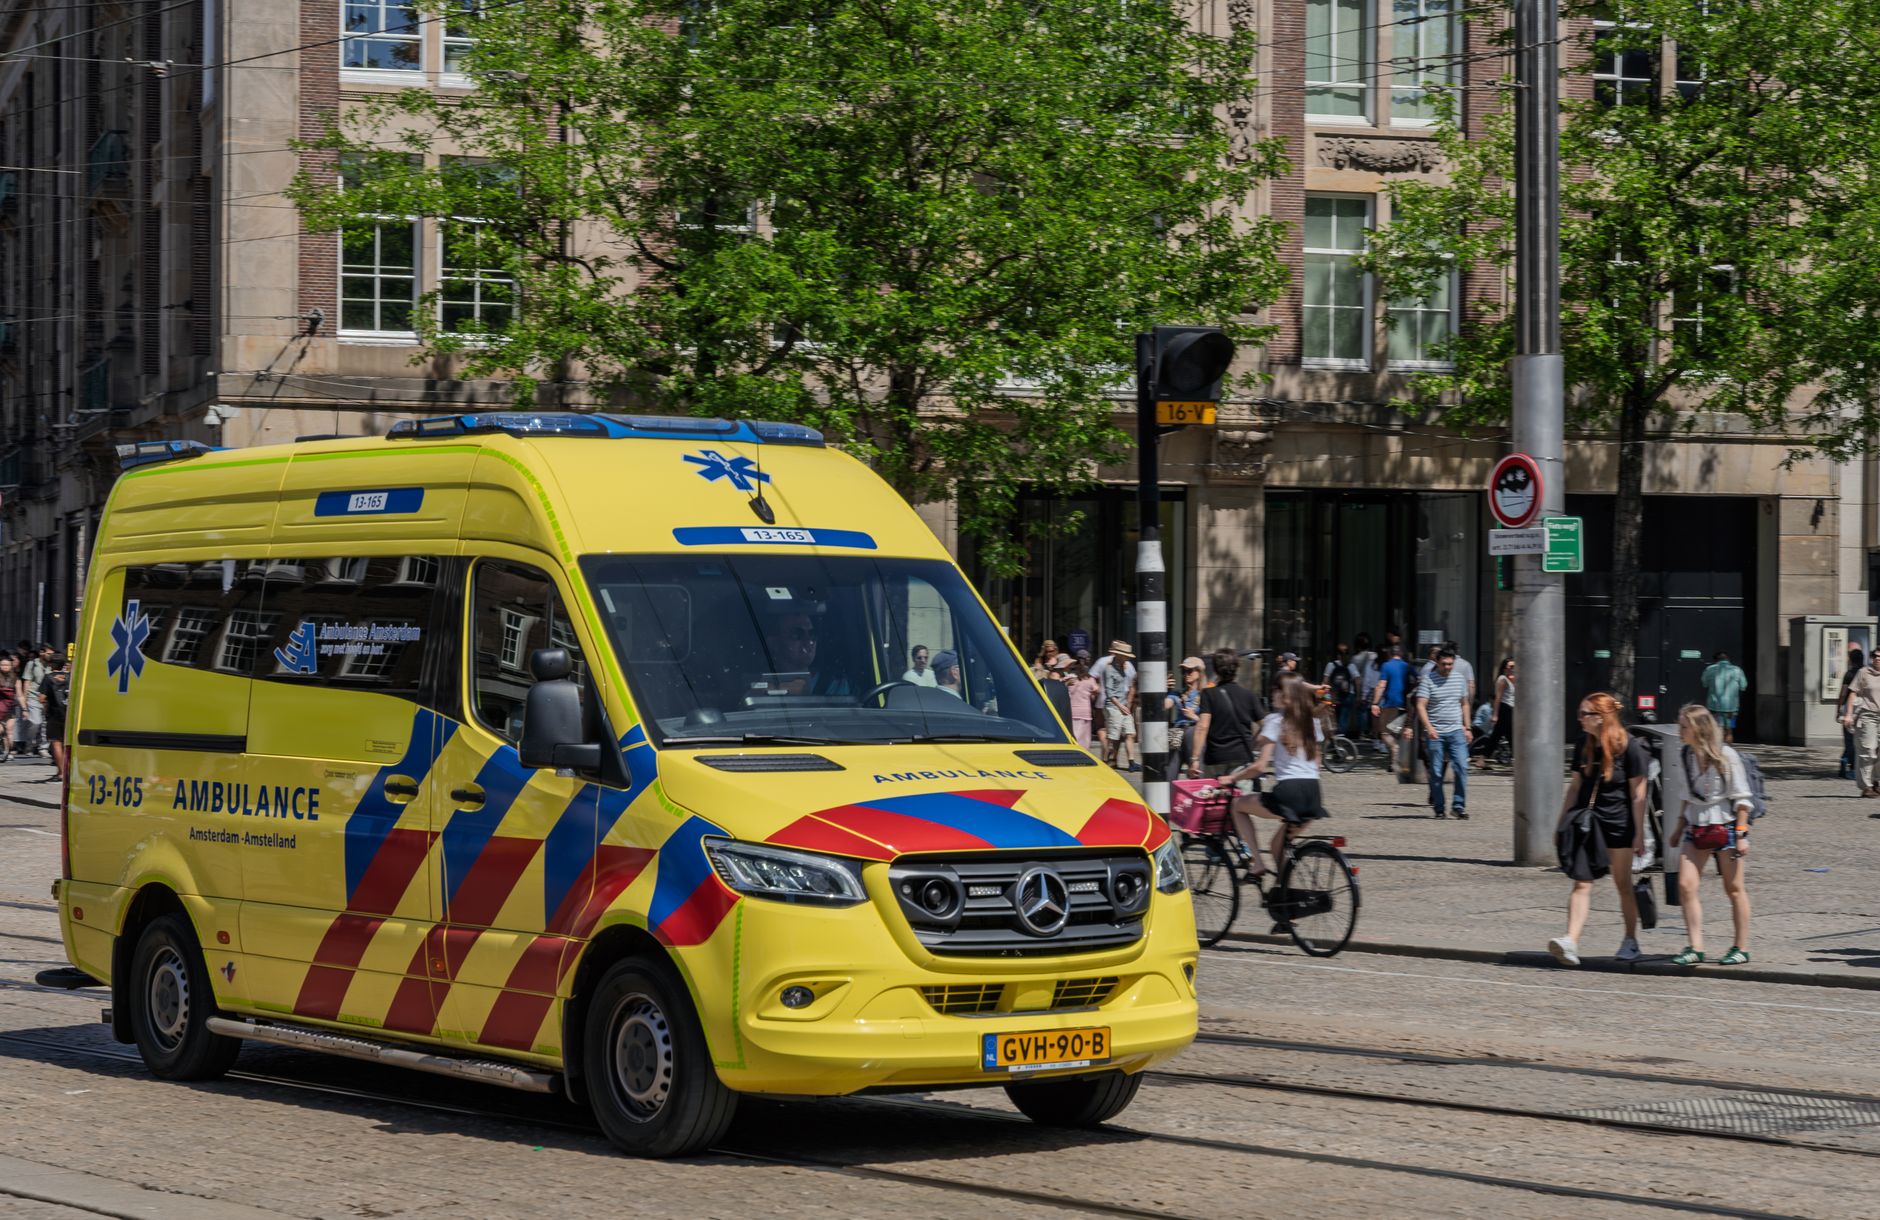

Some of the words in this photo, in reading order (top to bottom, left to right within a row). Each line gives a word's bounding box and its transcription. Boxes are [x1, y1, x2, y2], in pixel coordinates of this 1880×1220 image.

[1167, 404, 1205, 421] 16-V
[354, 495, 383, 509] 13-165
[753, 529, 806, 541] 13-165
[319, 622, 368, 640] Ambulance
[368, 622, 421, 641] Amsterdam
[872, 769, 1054, 784] AMBULANCE
[88, 774, 144, 808] 13-165
[172, 778, 320, 821] AMBULANCE
[1003, 1032, 1104, 1062] GVH-90-B
[986, 1053, 996, 1061] NL
